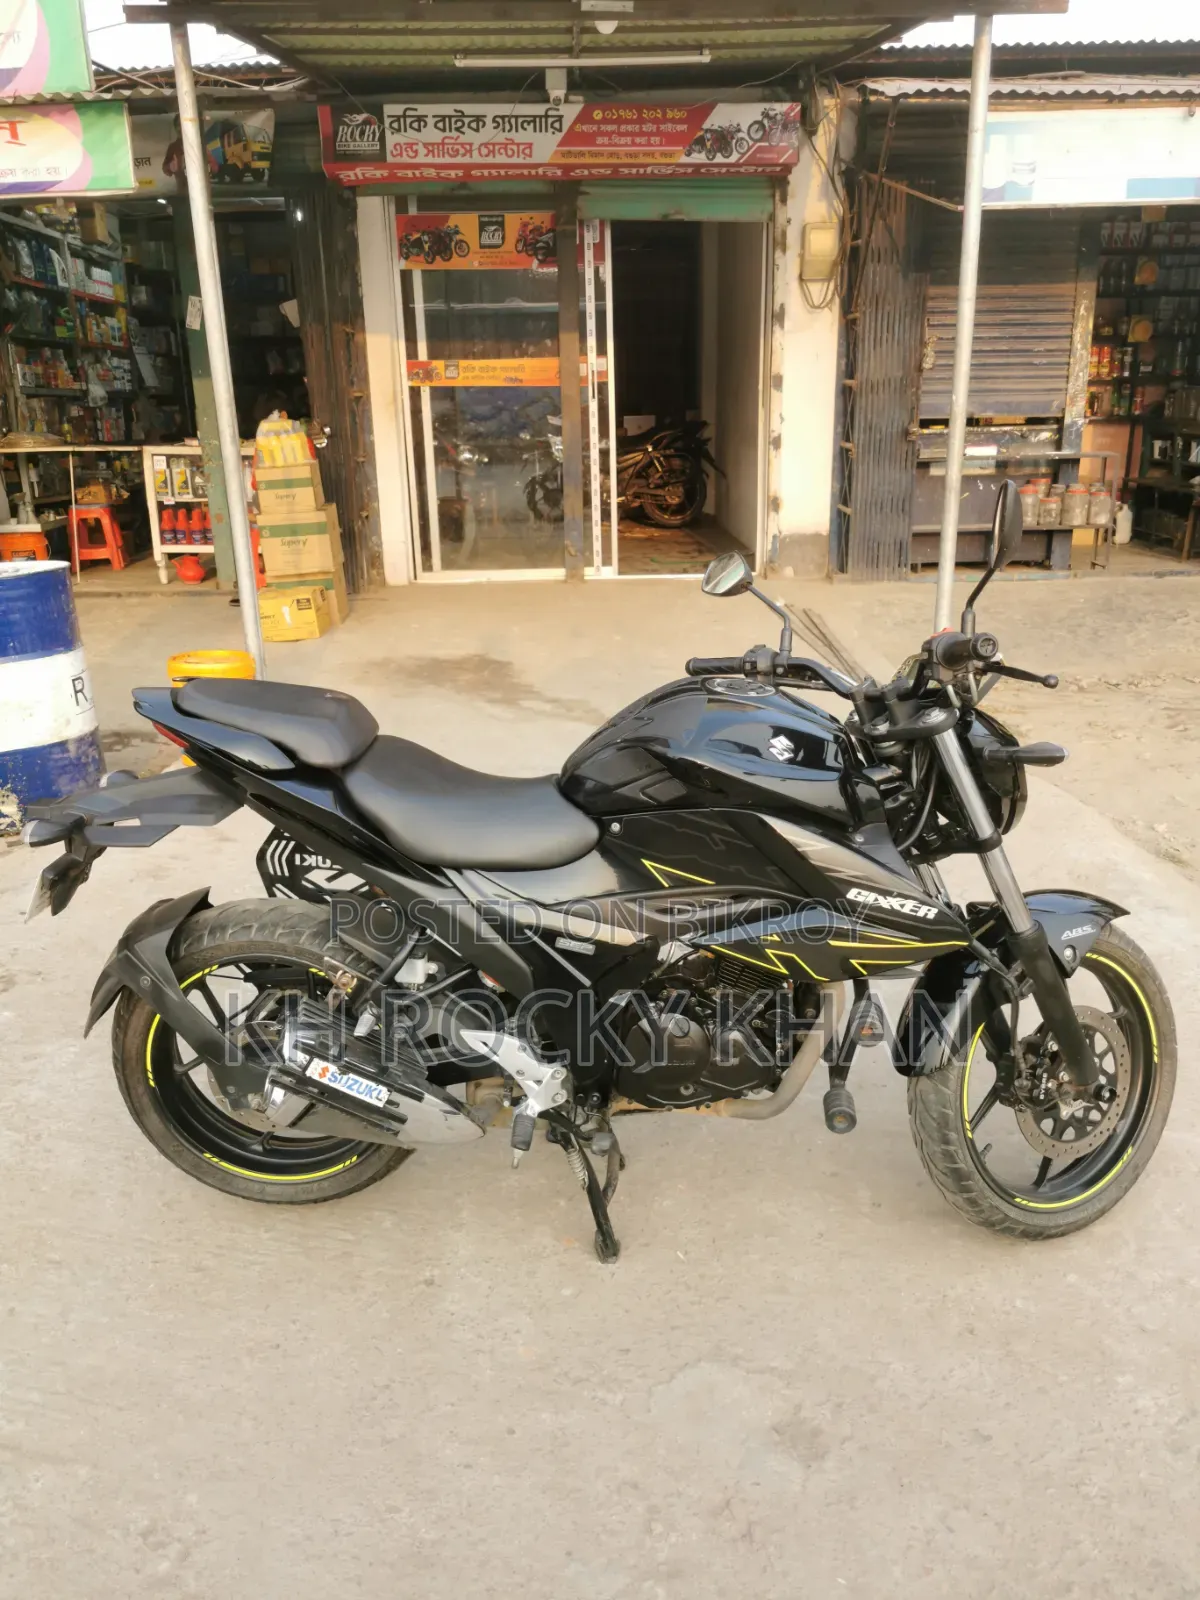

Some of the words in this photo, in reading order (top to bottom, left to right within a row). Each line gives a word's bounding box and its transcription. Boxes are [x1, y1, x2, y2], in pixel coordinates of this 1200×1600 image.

[387, 107, 428, 135] রকি
[432, 109, 487, 135] বাইক
[492, 107, 564, 135] গ্যালারি
[642, 109, 662, 119] ২০২
[336, 125, 383, 142] ROCKY
[390, 140, 419, 159] এন্ড
[423, 135, 474, 159] সার্ভিস
[478, 138, 533, 160] সেন্টার
[335, 167, 389, 181] রকি
[394, 168, 464, 179] বাইক
[470, 166, 564, 177] গ্যালারি
[569, 166, 613, 177] এন্ড
[618, 165, 695, 175] সার্ভিস
[700, 165, 785, 175] সেন্টার
[846, 887, 939, 920] GIXXER
[1061, 924, 1096, 940] ABS
